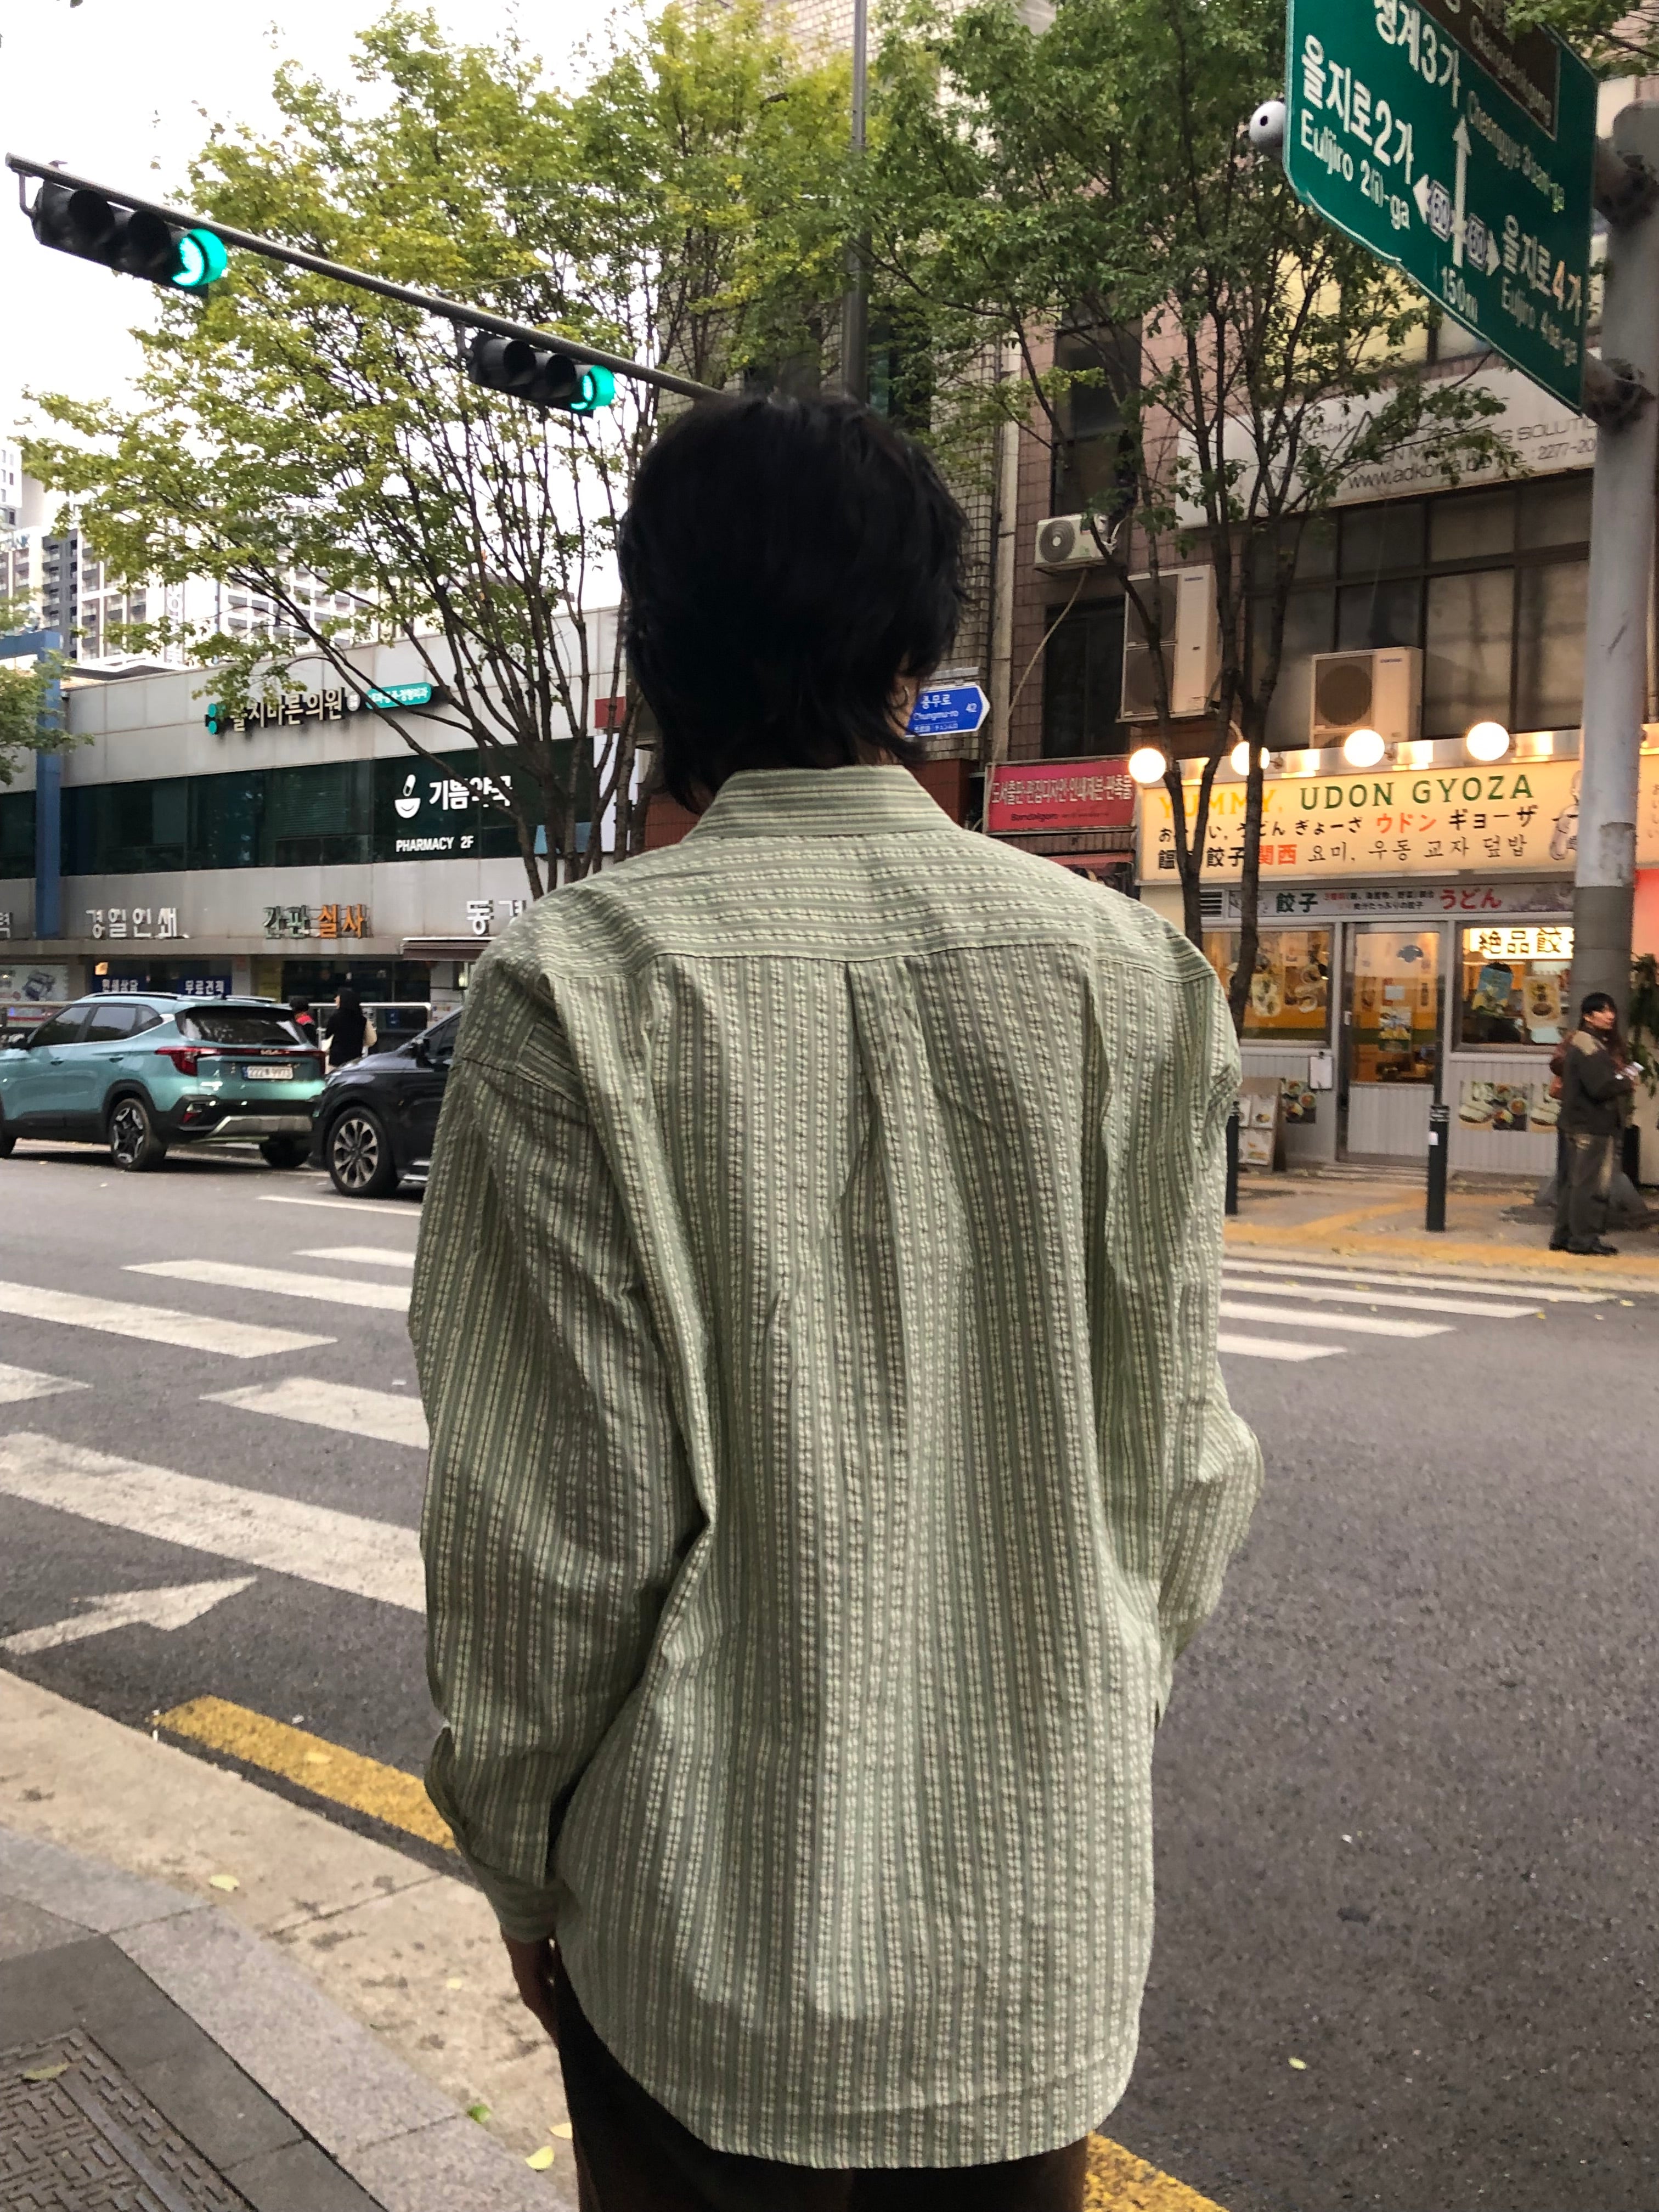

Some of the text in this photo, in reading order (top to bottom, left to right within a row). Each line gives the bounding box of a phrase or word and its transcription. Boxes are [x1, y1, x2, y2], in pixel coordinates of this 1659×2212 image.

[1301, 33, 1414, 185] 을지로2가
[1502, 215, 1582, 326] 을지로4가
[1441, 266, 1479, 323] 150m
[921, 694, 952, 709] 충무로
[1300, 782, 1395, 810] UDON
[1412, 774, 1534, 804] GYOZA
[1376, 813, 1437, 833] ウドン
[1449, 804, 1539, 830] ギョーザ
[395, 835, 475, 853] PHARMACY 2F
[1368, 839, 1412, 861] 우동
[1424, 836, 1470, 859] 교자
[1482, 834, 1527, 859] 덮밥
[1276, 892, 1318, 913] 餃子
[1440, 888, 1504, 910] うどん
[86, 907, 178, 939] 경일인쇄
[318, 904, 365, 939] 실사
[1479, 927, 1575, 955] 絶品餃
